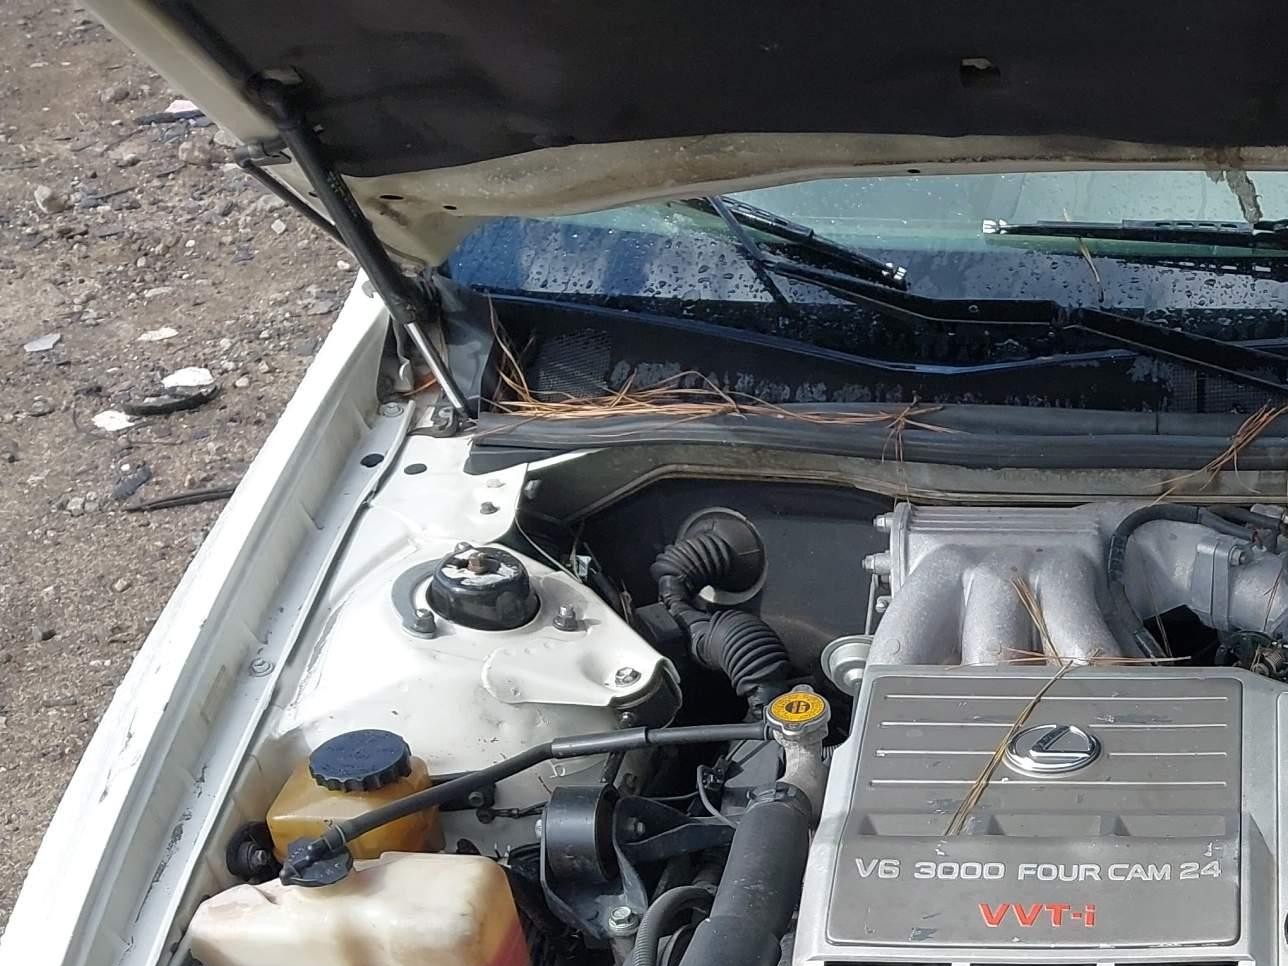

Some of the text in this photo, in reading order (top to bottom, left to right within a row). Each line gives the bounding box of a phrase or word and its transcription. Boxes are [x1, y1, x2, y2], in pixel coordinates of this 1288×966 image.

[855, 858, 1222, 882] V6 3000 FOUR CAM 24
[978, 903, 1097, 929] VVT-i
